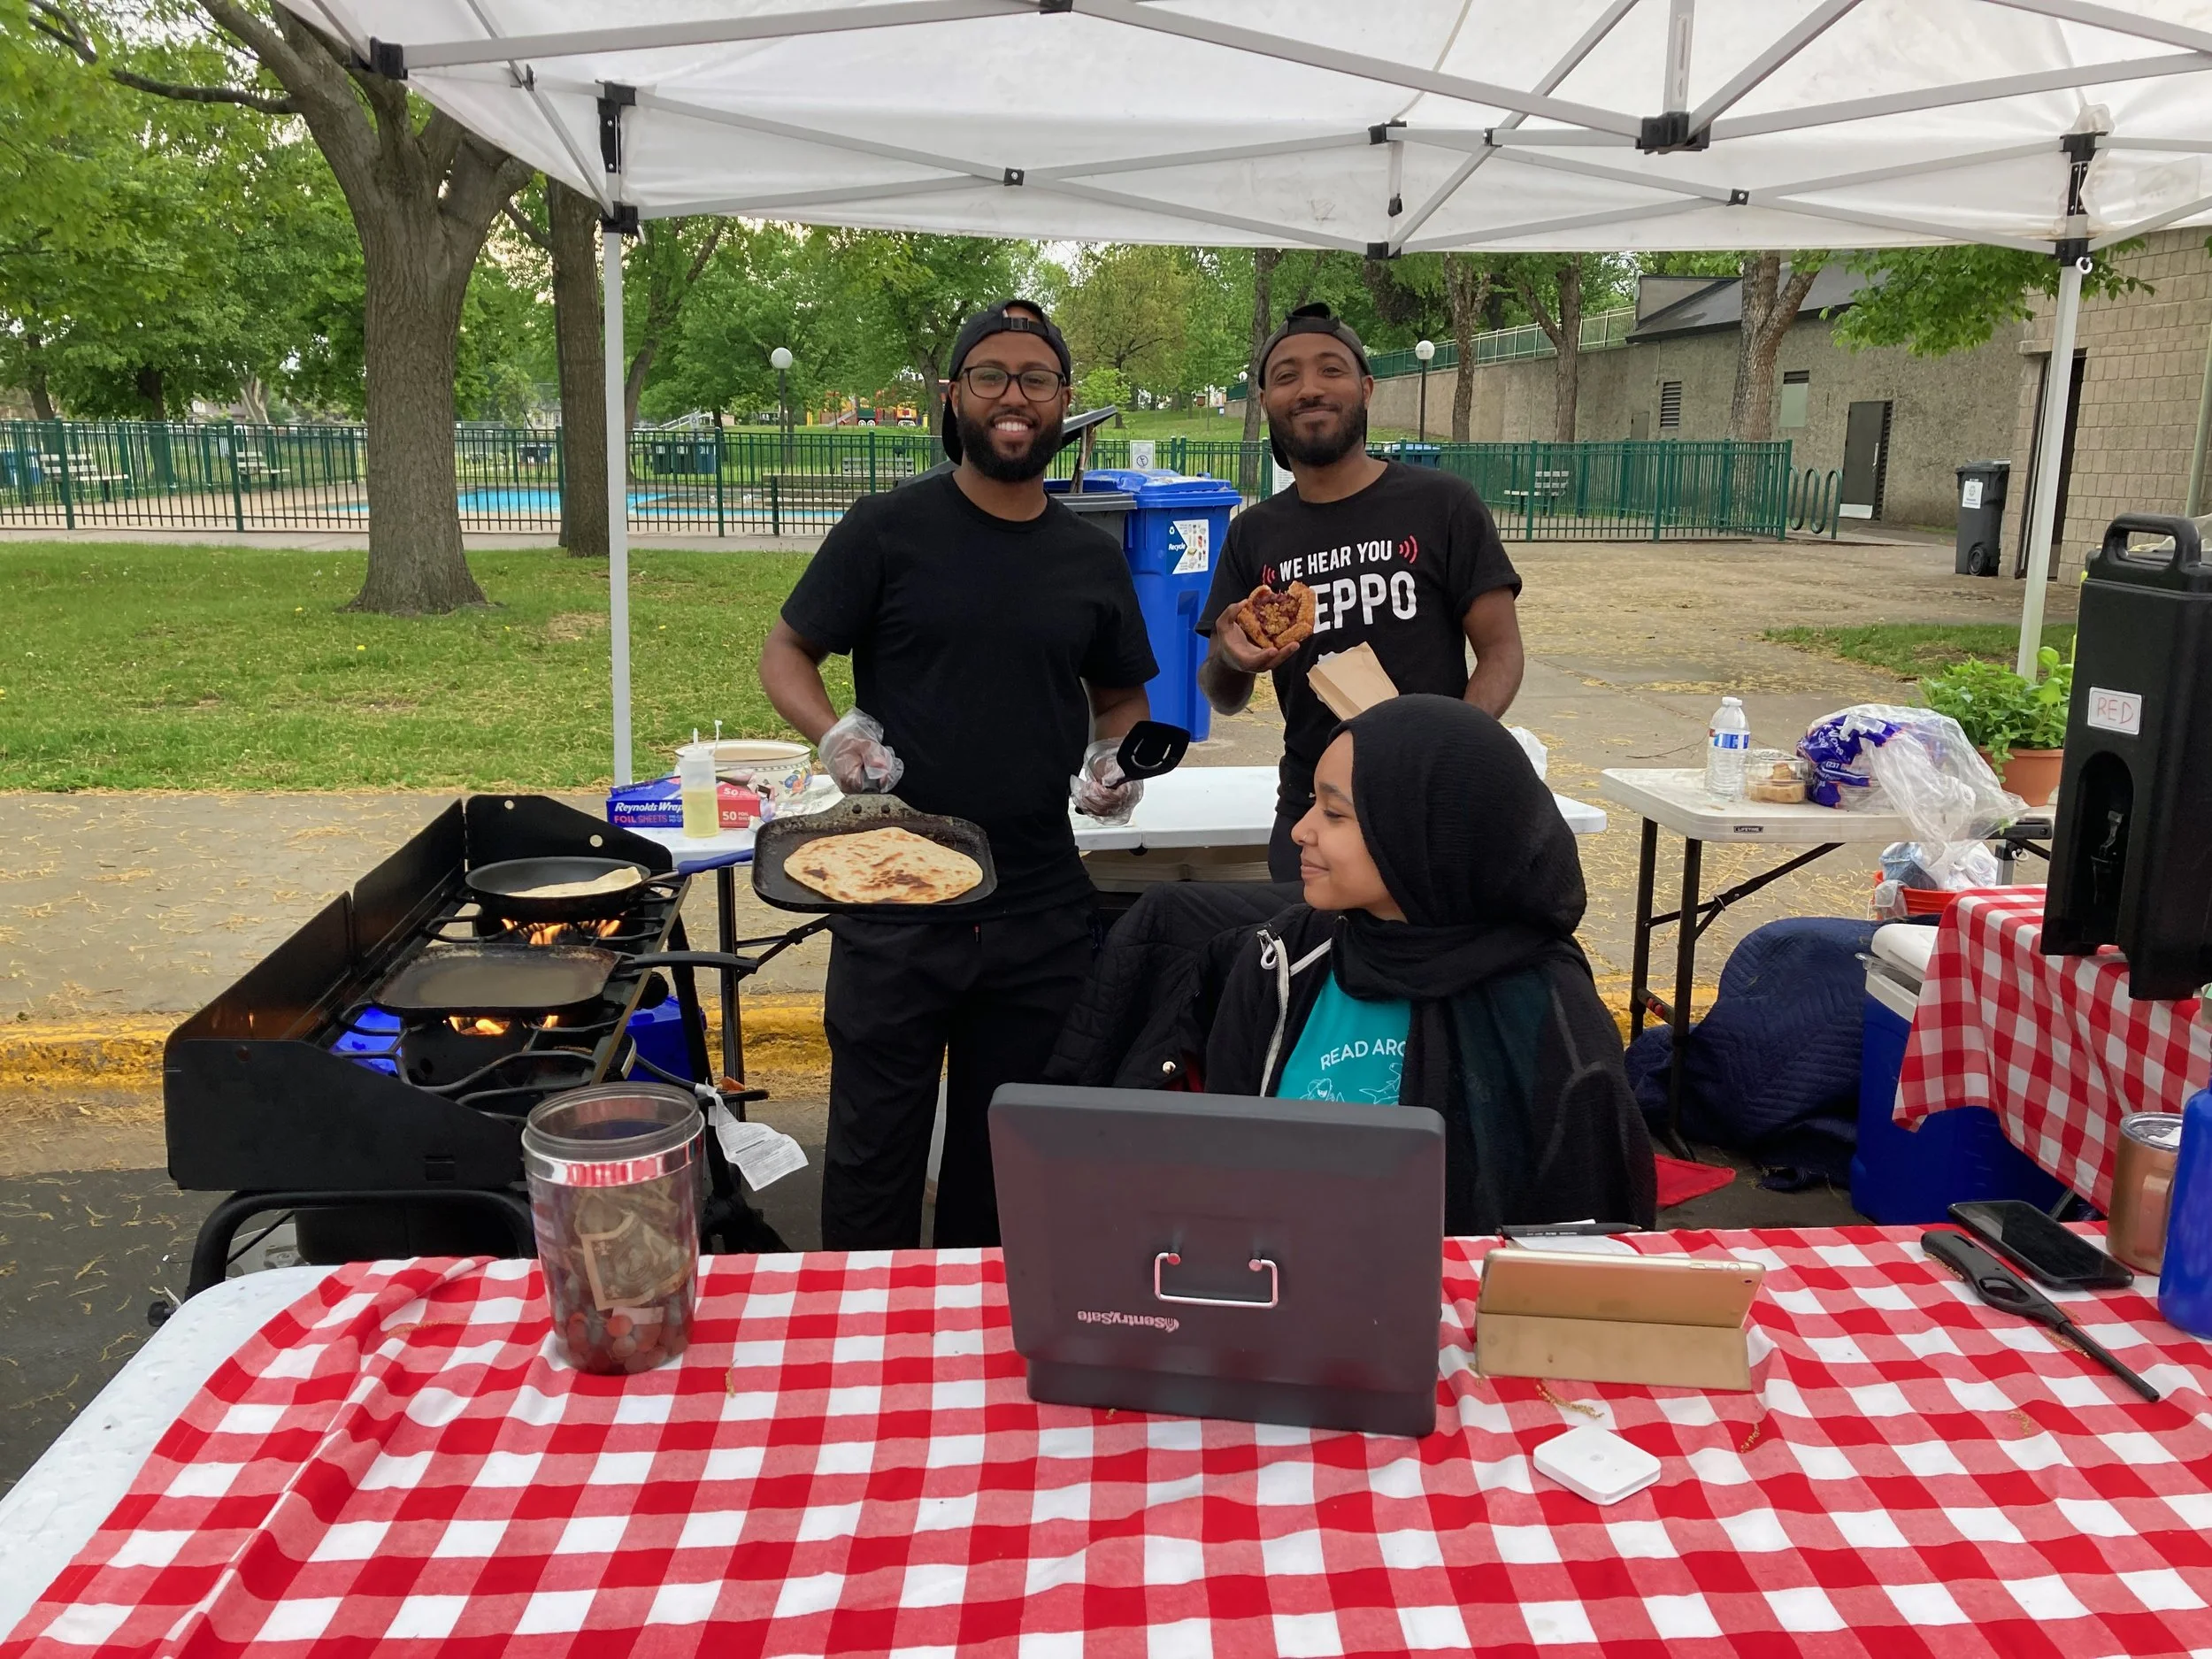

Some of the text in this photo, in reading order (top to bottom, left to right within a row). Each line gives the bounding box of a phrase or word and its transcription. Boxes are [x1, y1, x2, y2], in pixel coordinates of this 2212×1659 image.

[1168, 542, 1186, 551] Recycle
[1279, 540, 1392, 582] WE HEAR YOU
[2097, 696, 2133, 724] RED
[615, 803, 657, 813] Reynolds
[722, 811, 737, 820] 50
[1320, 1041, 1369, 1071] READ
[1077, 1310, 1164, 1328] SentrySafe
